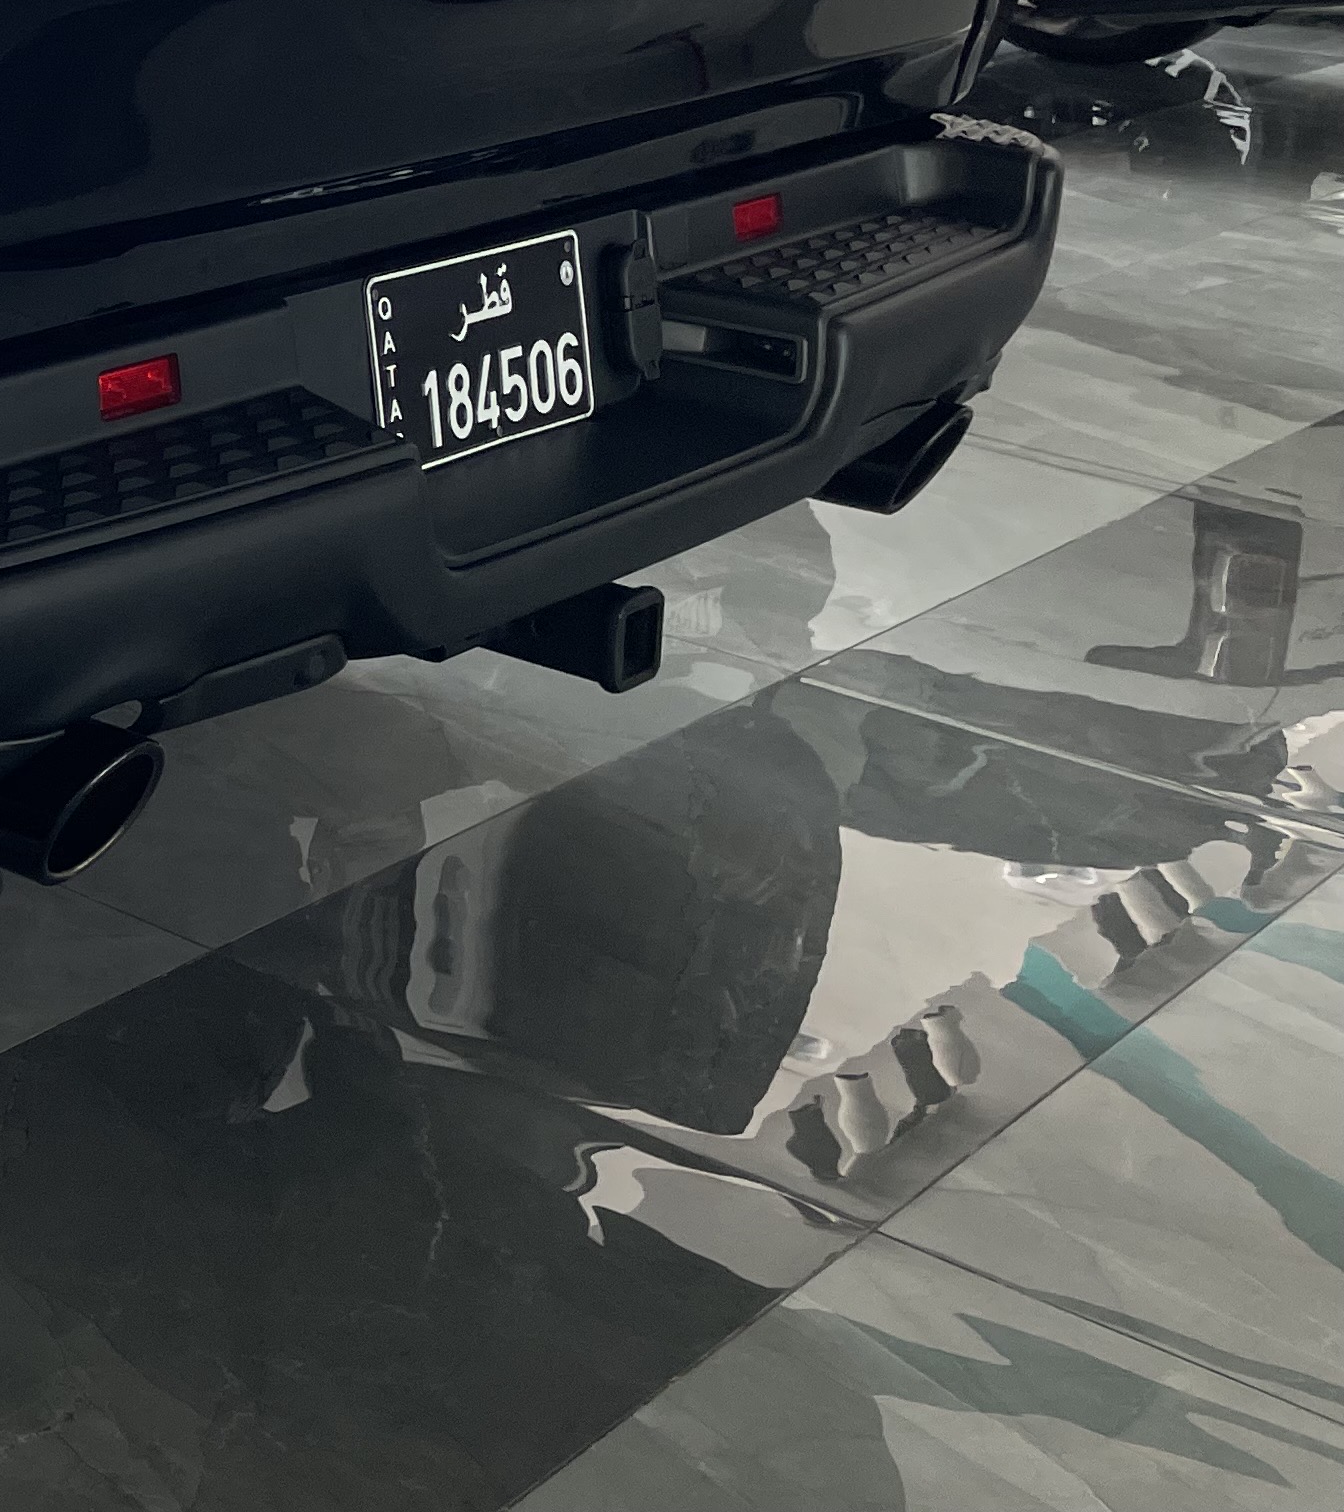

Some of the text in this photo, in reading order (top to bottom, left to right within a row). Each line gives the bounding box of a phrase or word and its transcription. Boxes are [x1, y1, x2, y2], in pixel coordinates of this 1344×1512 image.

[448, 262, 513, 342] قطر
[378, 296, 404, 438] QATA
[422, 332, 584, 448] 184506
